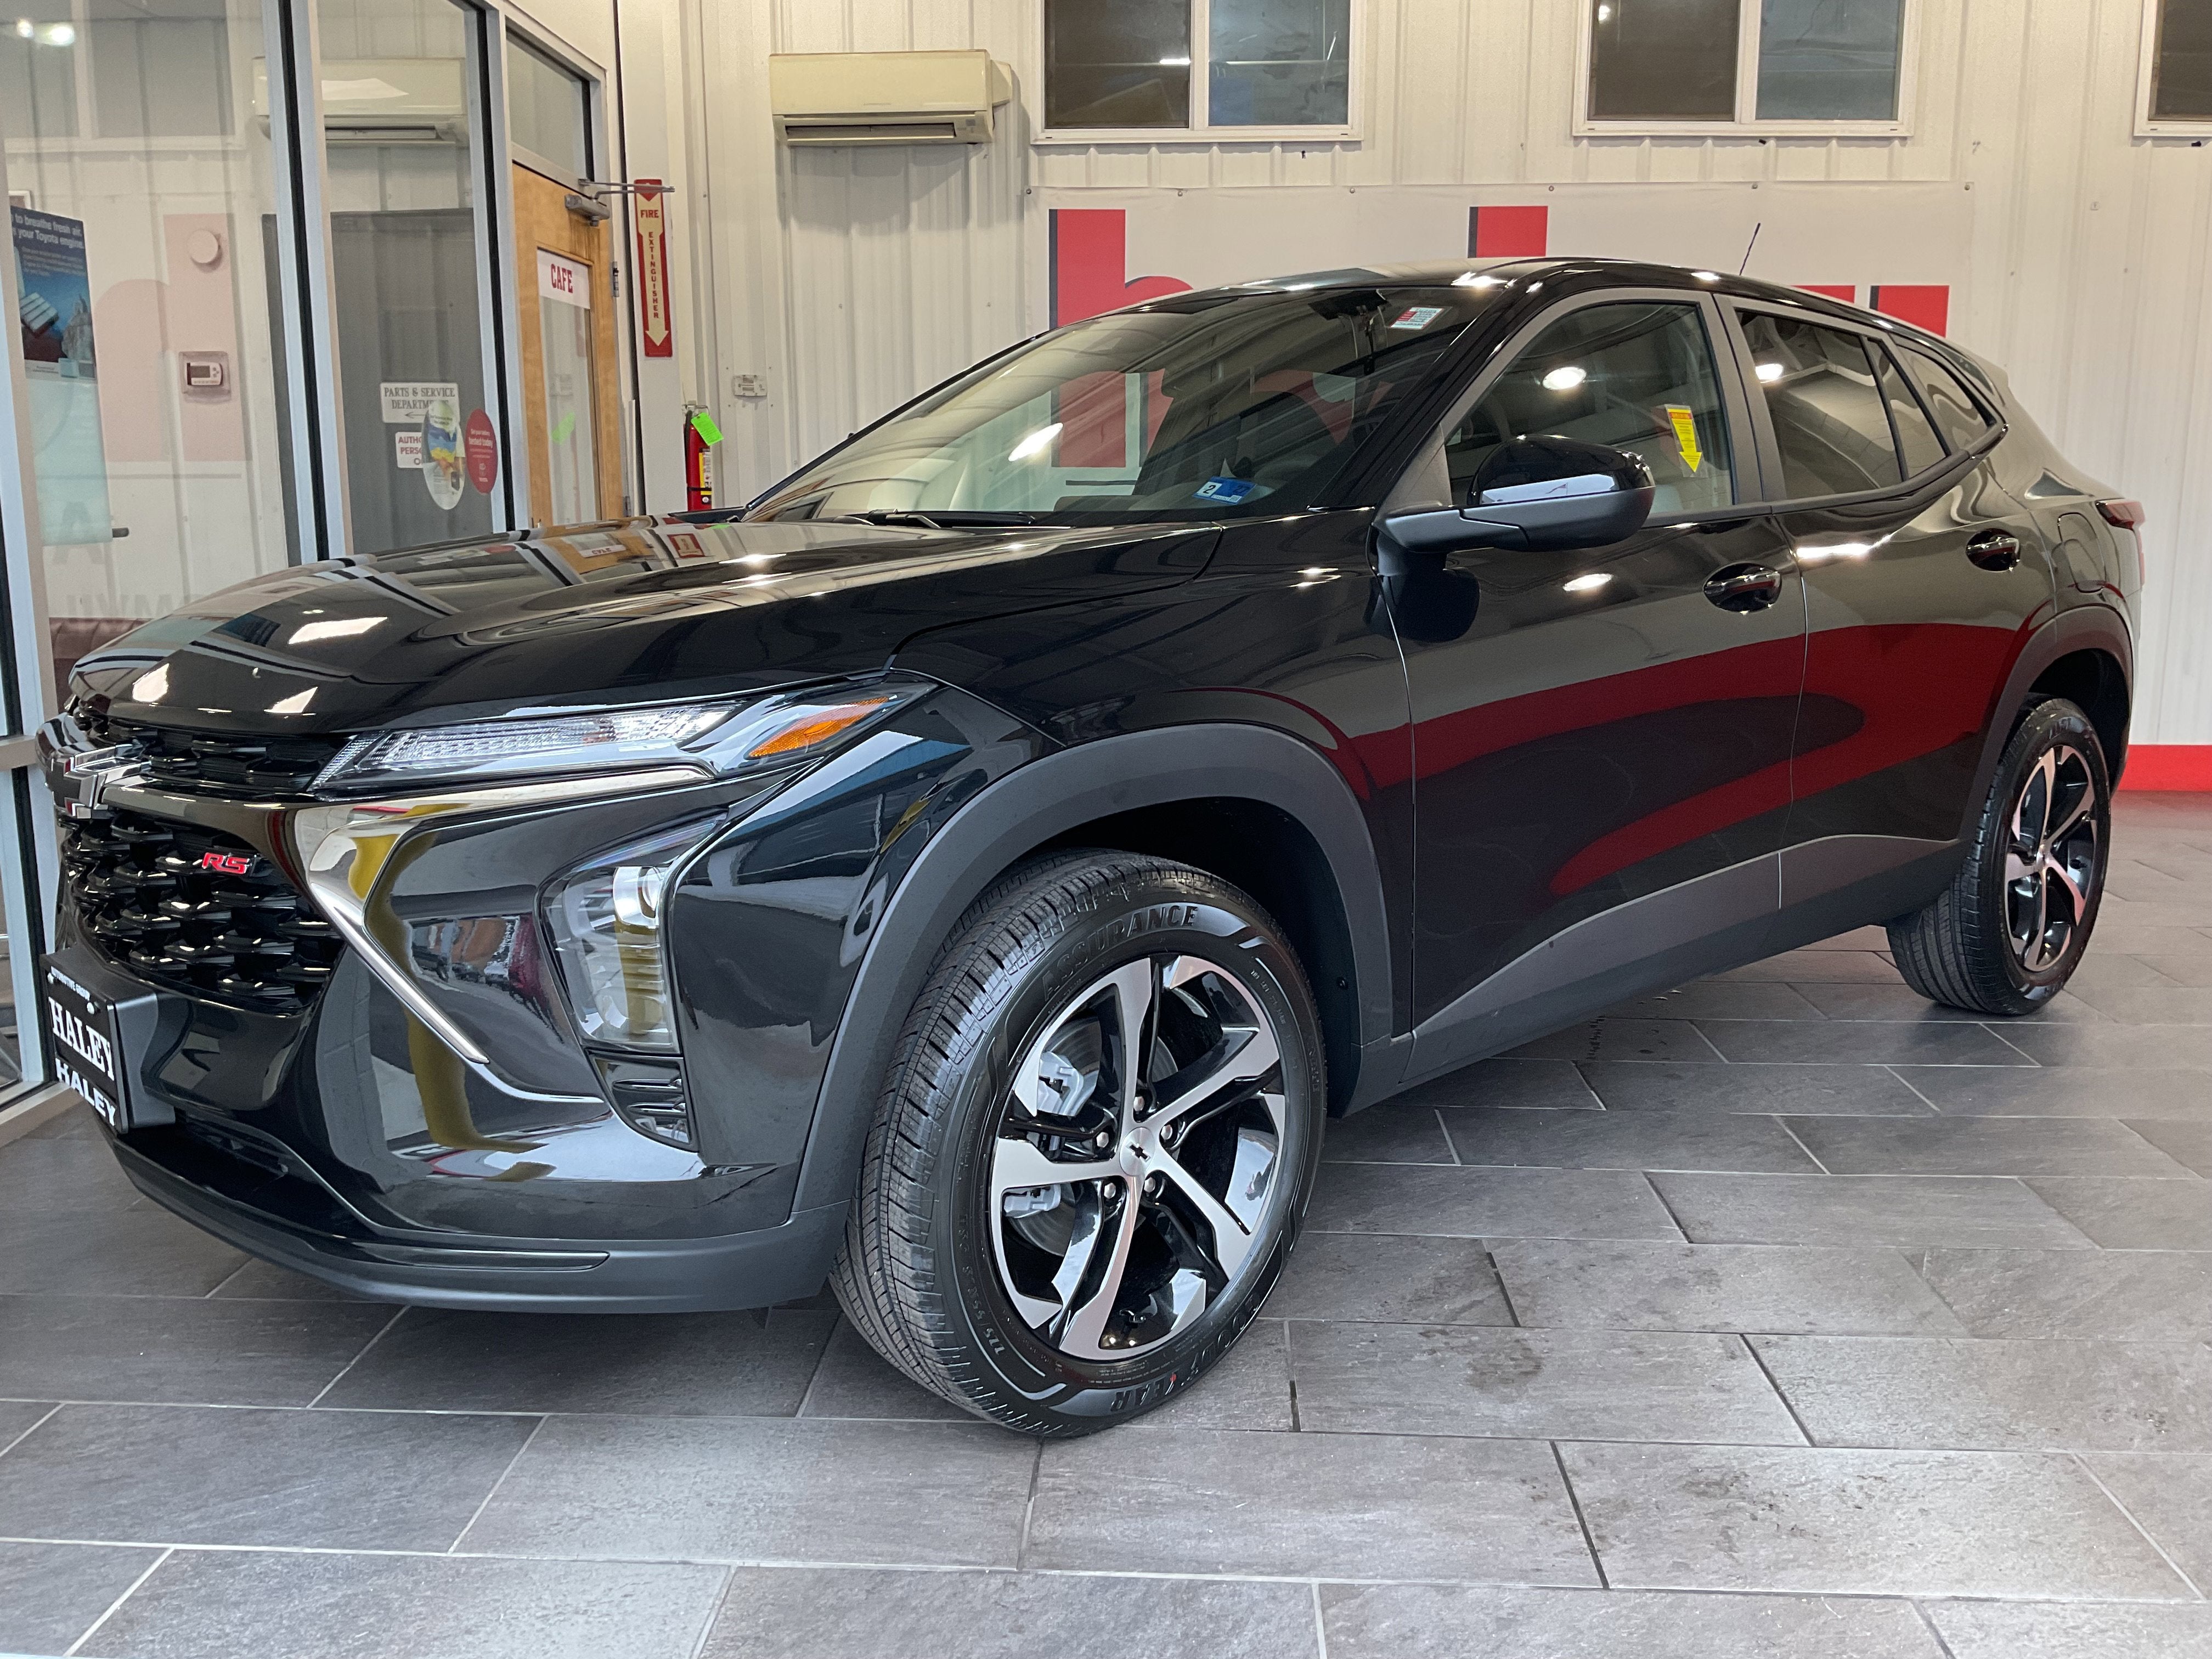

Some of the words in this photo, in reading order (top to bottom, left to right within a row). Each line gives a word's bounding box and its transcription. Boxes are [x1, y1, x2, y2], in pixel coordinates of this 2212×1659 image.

[640, 210, 659, 218] FIRE
[53, 221, 71, 234] fresh
[18, 228, 34, 239] your
[35, 229, 59, 244] Toyota
[551, 263, 573, 294] CAFE
[648, 232, 659, 318] EXTINGUISHER
[384, 387, 409, 397] PARTS
[412, 387, 419, 397] &
[421, 387, 455, 397] SERVICE
[392, 399, 449, 409] DEPARTM
[1203, 484, 1216, 494] 2
[201, 852, 250, 874] RS
[48, 996, 114, 1081] HALEY
[55, 1058, 117, 1126] HALEY
